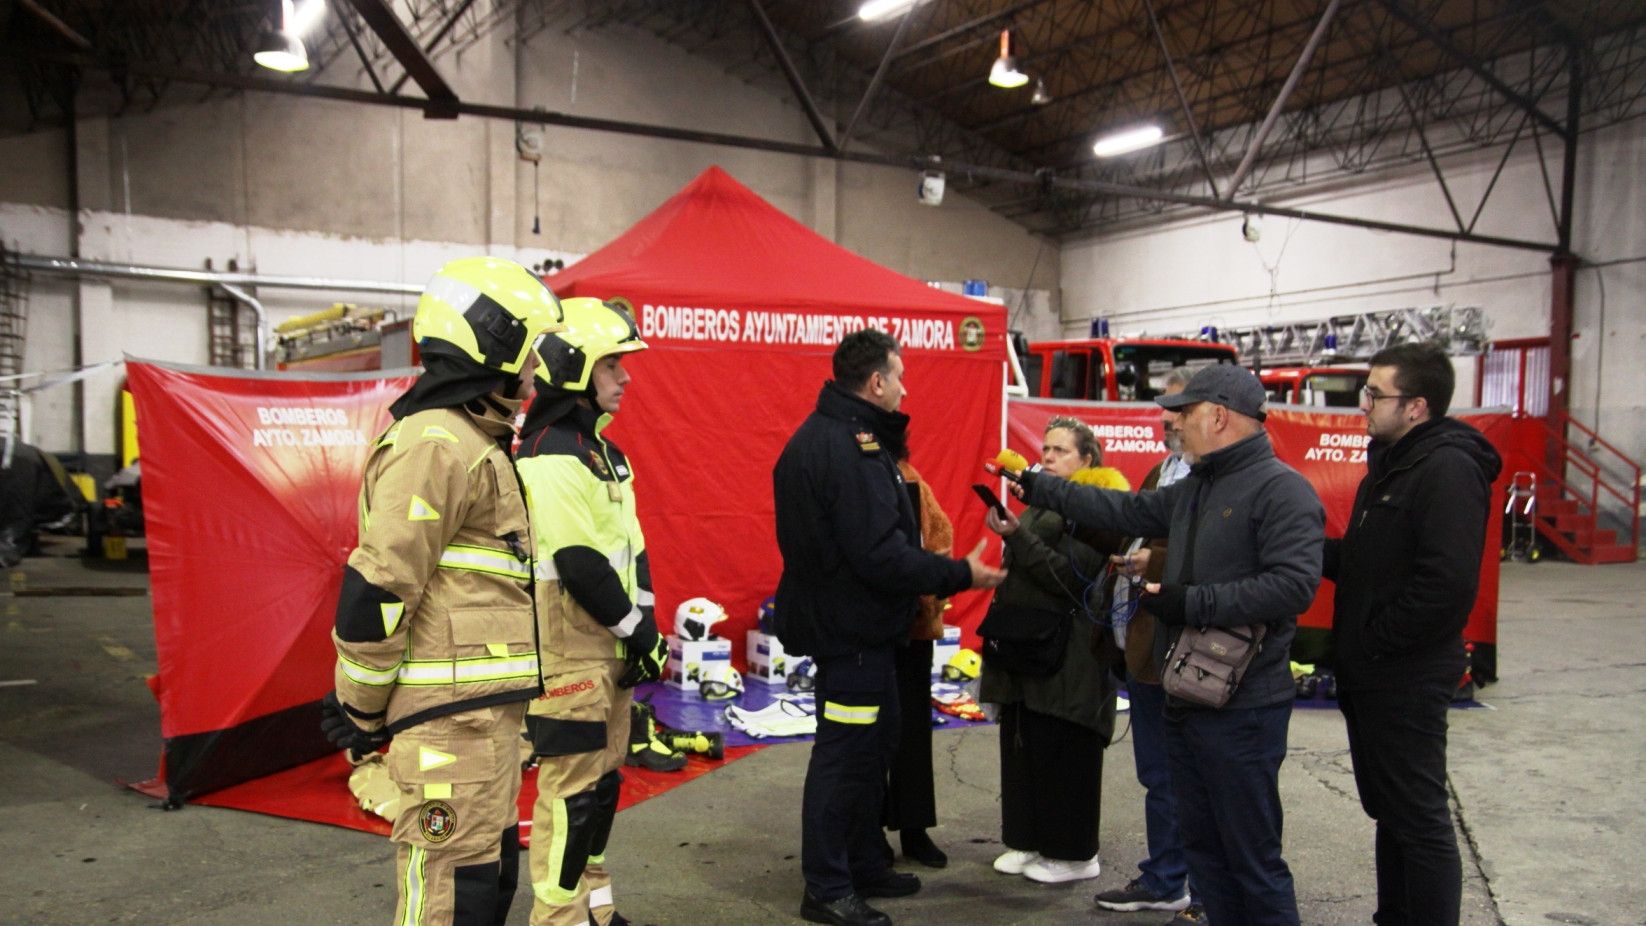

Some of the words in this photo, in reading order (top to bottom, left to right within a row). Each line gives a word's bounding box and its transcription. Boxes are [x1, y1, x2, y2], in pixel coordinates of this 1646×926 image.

[642, 304, 740, 341] BOMBEROS
[742, 311, 865, 345] AYUNTAMIENTO
[891, 317, 955, 350] ZAMORA
[257, 407, 348, 425] BOMBEROS
[300, 429, 367, 446] ZAMORA
[1088, 425, 1154, 439] MBEROS
[1105, 439, 1166, 453] ZAMORA
[1319, 433, 1372, 448] BOMBE
[1304, 447, 1347, 462] AYTO.
